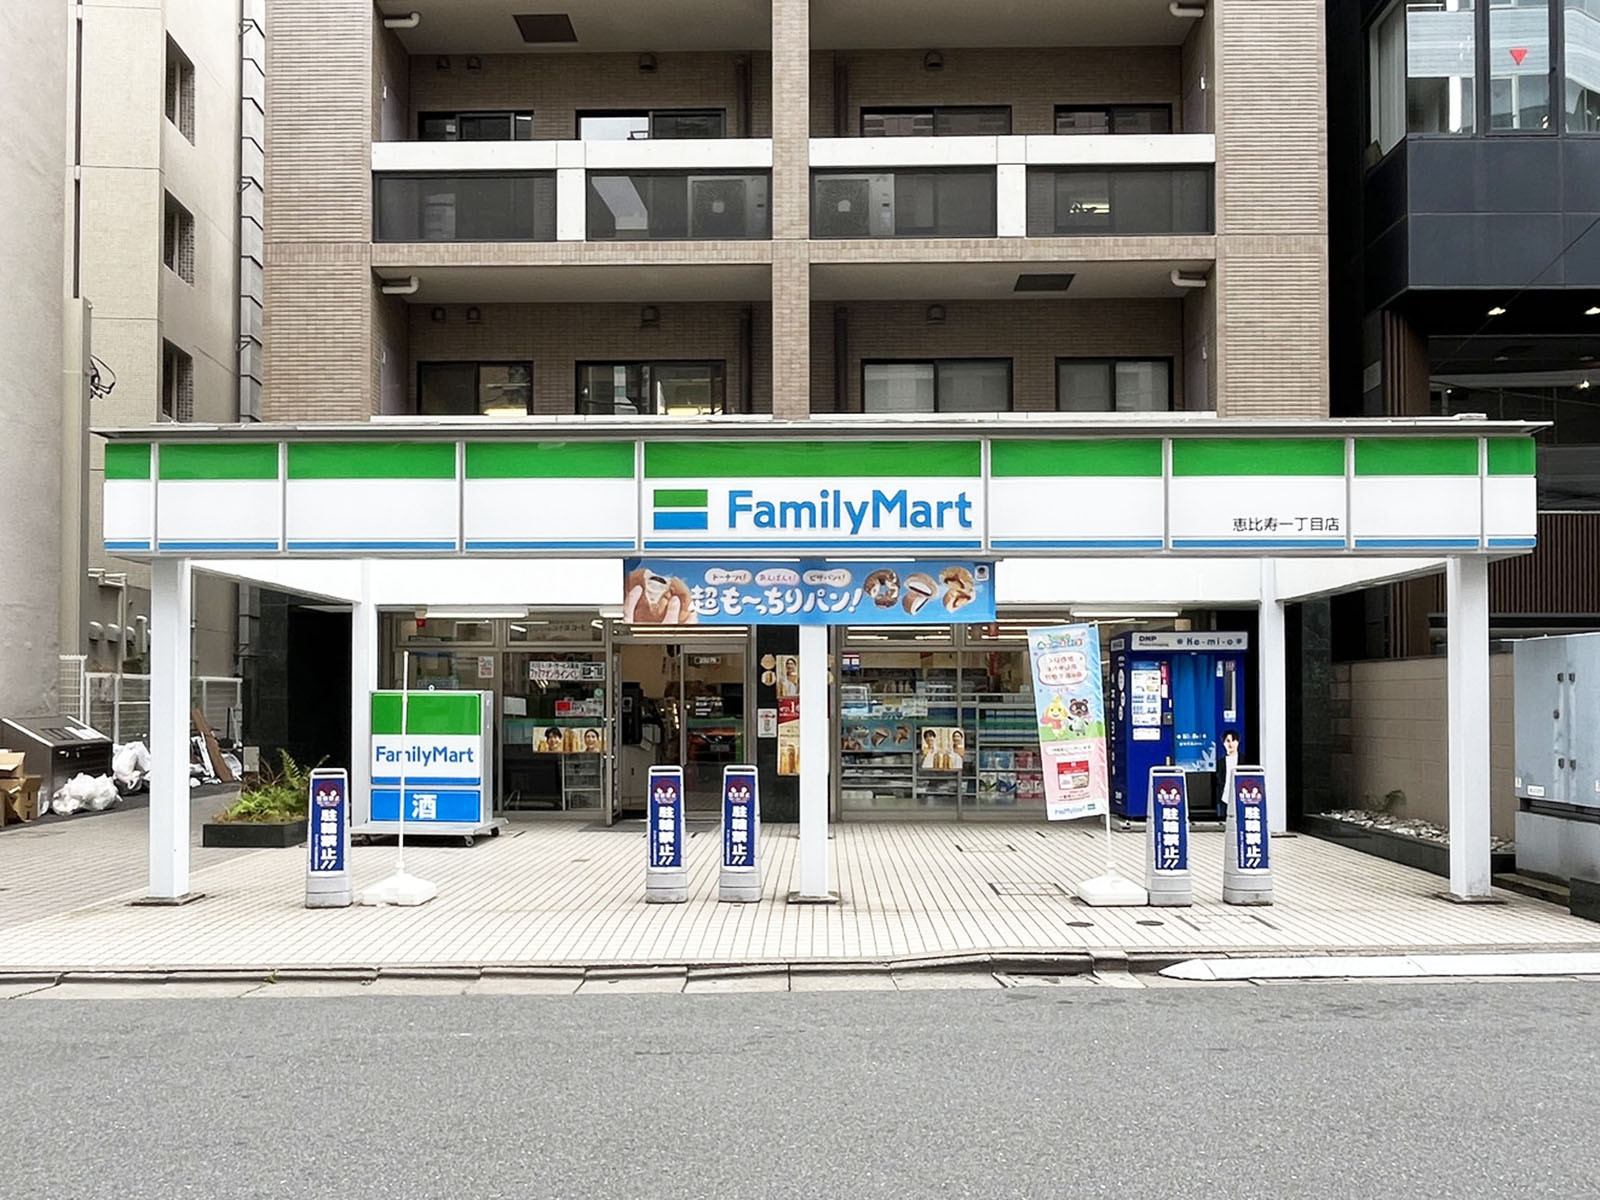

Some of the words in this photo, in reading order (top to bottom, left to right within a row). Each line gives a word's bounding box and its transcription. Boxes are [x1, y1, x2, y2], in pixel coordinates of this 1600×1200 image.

[729, 489, 972, 535] FamilyMart
[1233, 517, 1339, 531] 恵比寿一丁目店
[376, 746, 474, 767] FamilyMart
[412, 793, 438, 820] 酒
